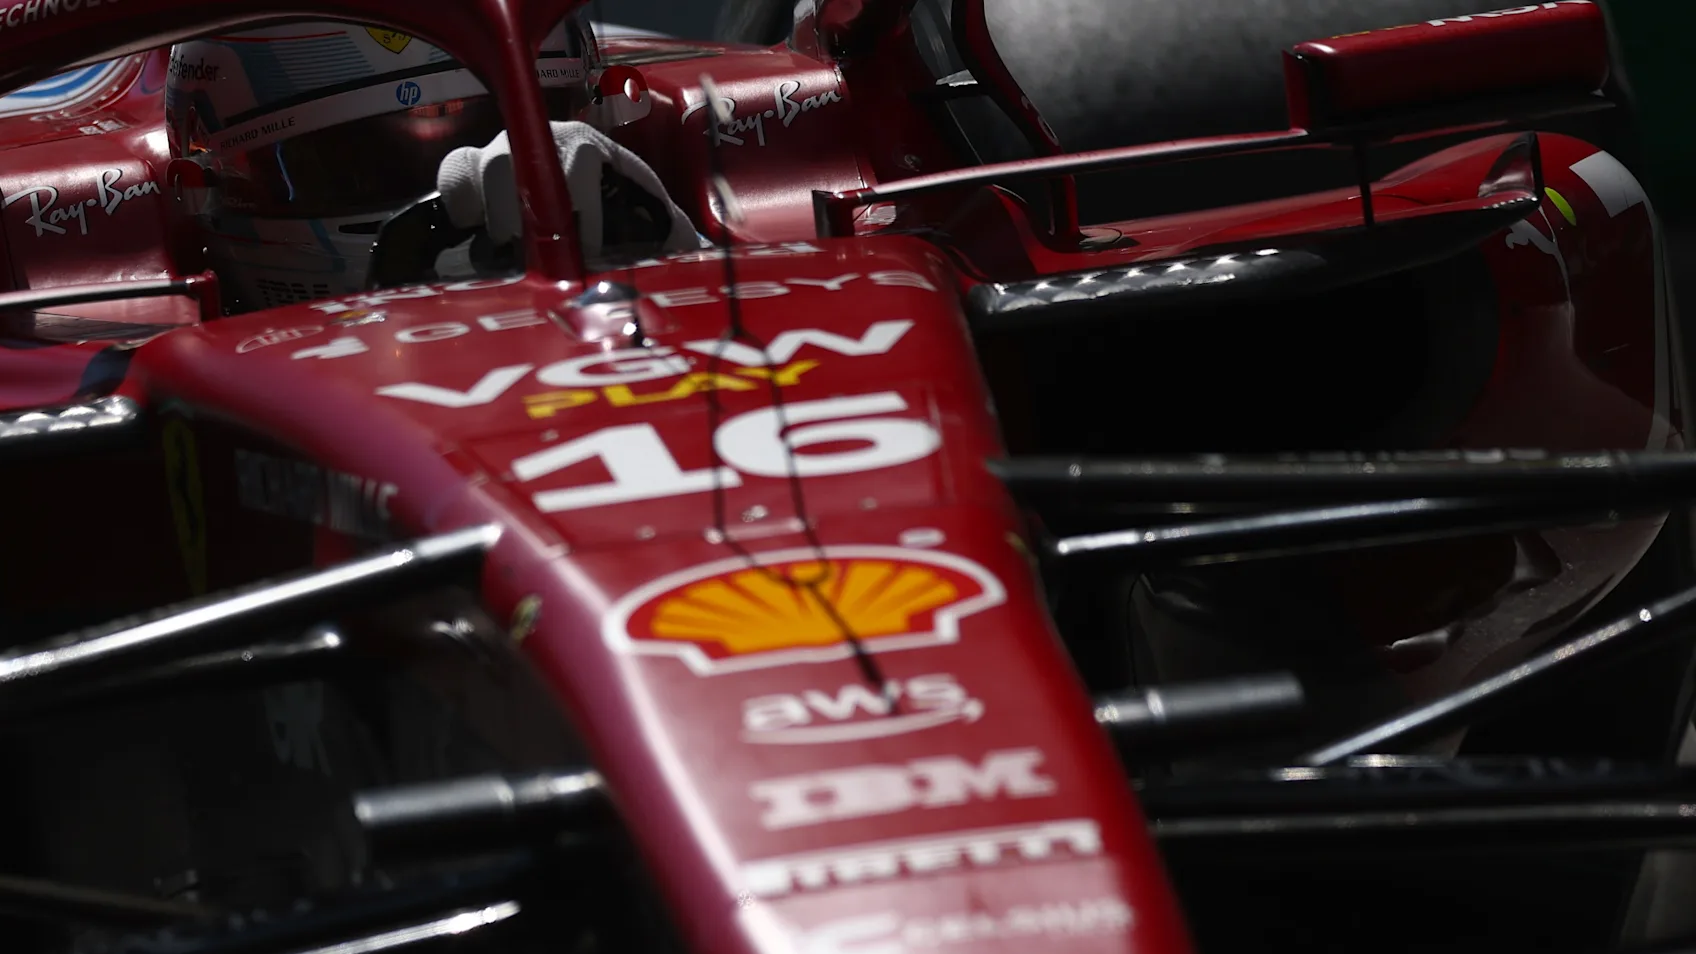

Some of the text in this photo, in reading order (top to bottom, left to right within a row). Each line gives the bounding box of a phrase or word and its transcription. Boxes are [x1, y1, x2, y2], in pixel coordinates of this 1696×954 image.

[398, 80, 420, 106] hp
[220, 116, 297, 150] RICHARD MILLE
[2, 168, 162, 238] Ray-Ban
[393, 269, 939, 344] GEESYS
[372, 318, 916, 409] VGW
[520, 358, 822, 420] PLAY
[509, 390, 943, 514] 16
